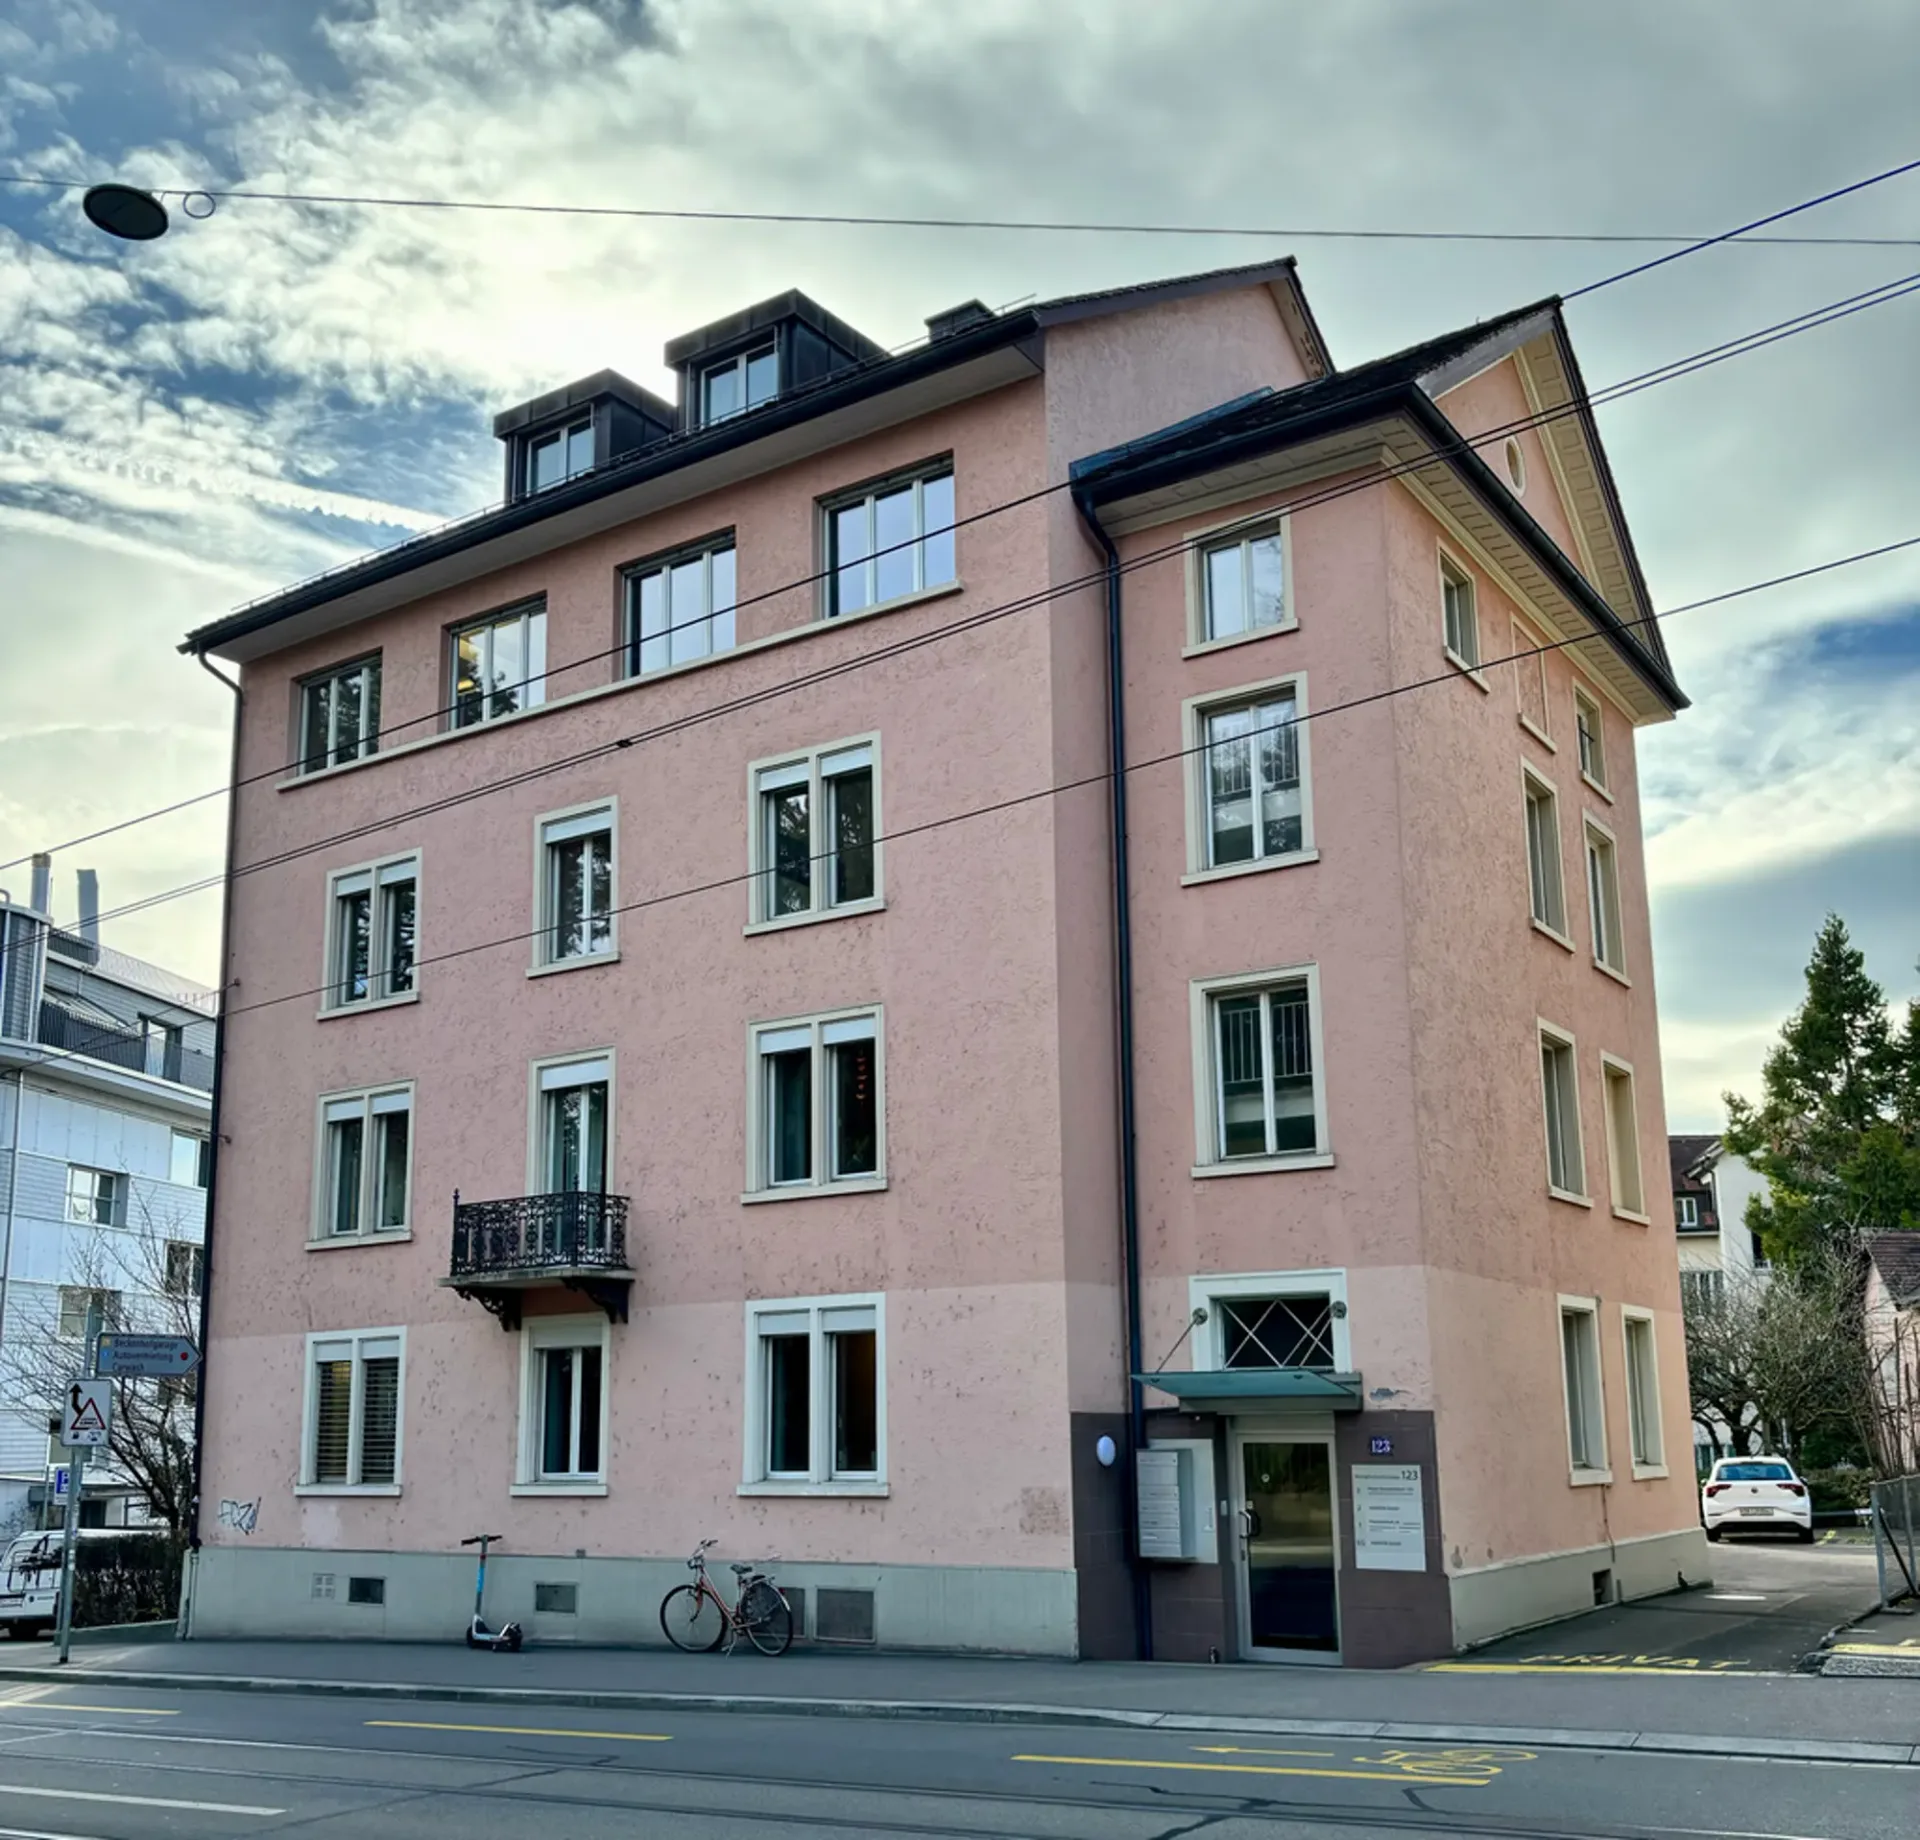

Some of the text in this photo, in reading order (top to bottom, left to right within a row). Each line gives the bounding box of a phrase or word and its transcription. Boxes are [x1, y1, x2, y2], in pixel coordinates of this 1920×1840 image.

[1371, 1439, 1391, 1454] 123
[1401, 1470, 1418, 1481] 123
[1518, 1654, 1751, 1669] PRIVAT
